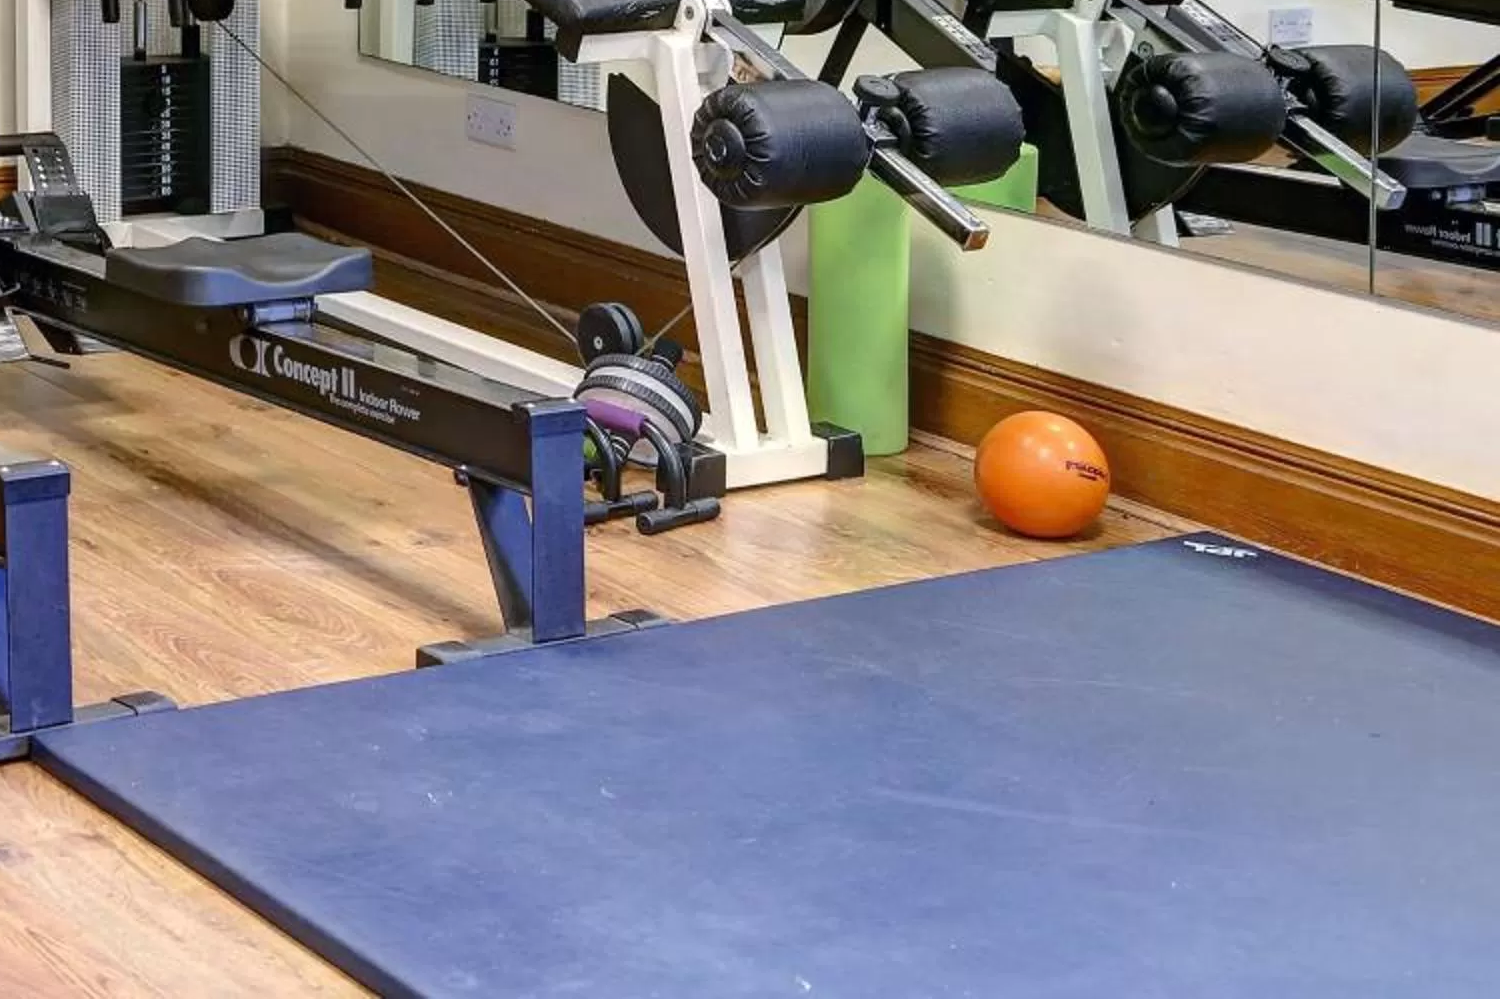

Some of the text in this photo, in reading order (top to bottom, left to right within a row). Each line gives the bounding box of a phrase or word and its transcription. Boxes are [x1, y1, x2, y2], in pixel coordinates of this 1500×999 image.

[273, 344, 421, 421] Concept II Indoor Rower
